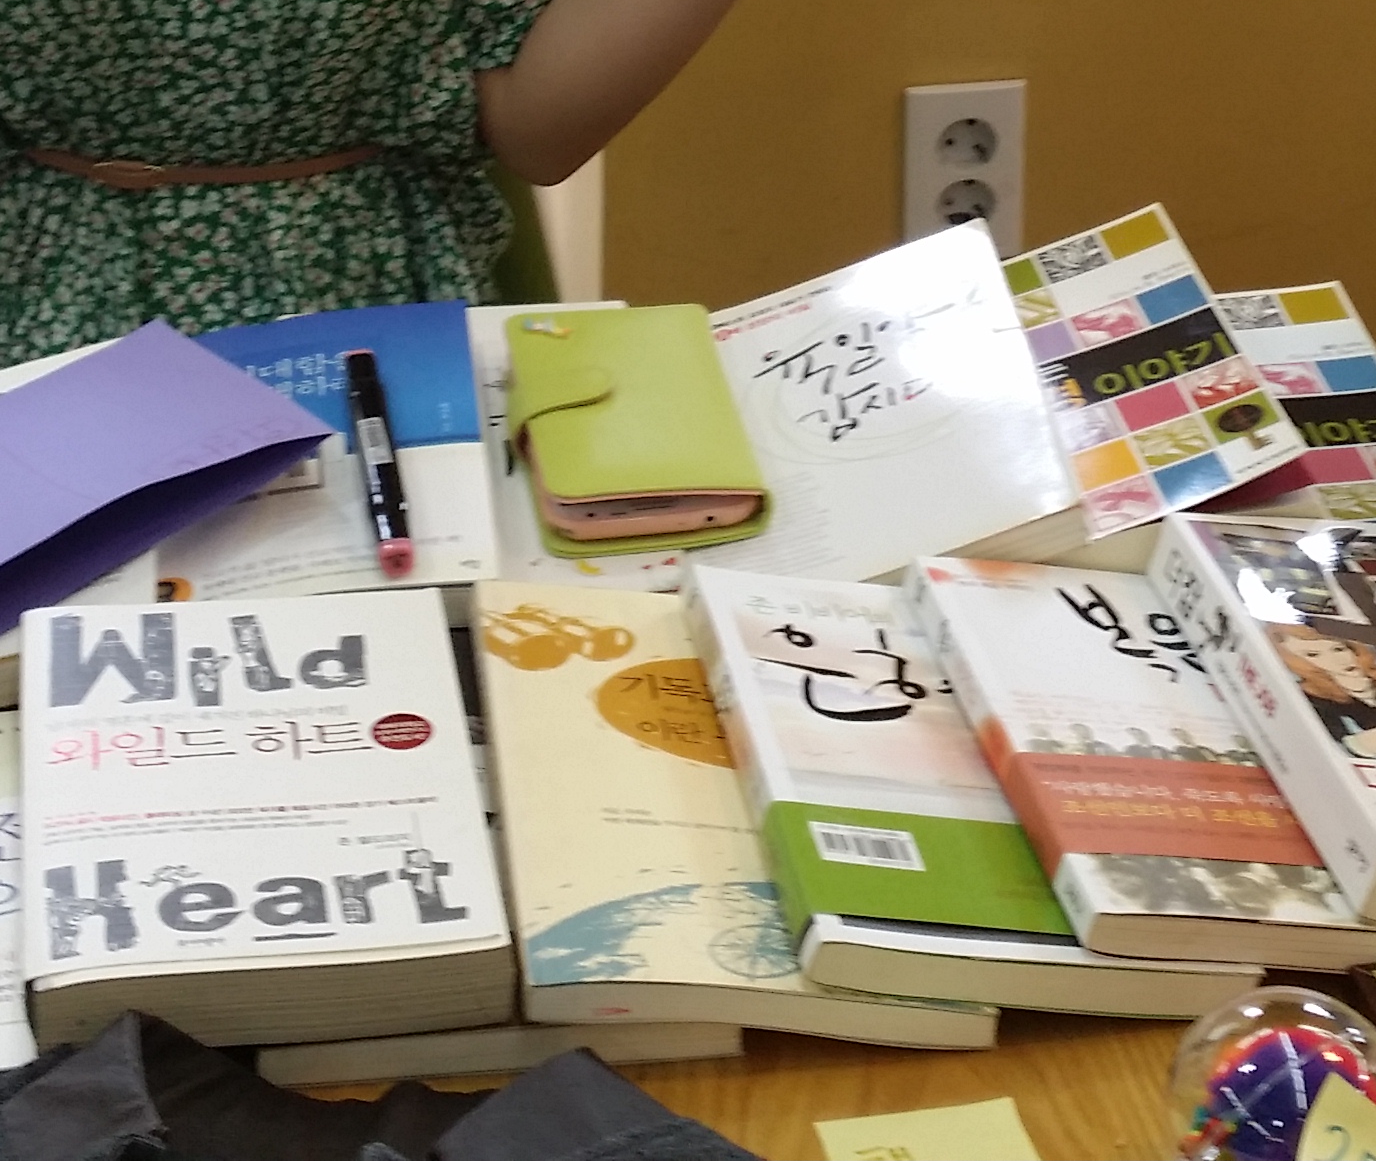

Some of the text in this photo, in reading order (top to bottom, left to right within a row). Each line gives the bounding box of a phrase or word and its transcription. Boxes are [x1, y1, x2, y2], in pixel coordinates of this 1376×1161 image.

[49, 612, 368, 707] Wild
[45, 725, 237, 771] 와일드
[245, 720, 375, 761] 하트
[43, 848, 470, 961] Heart
